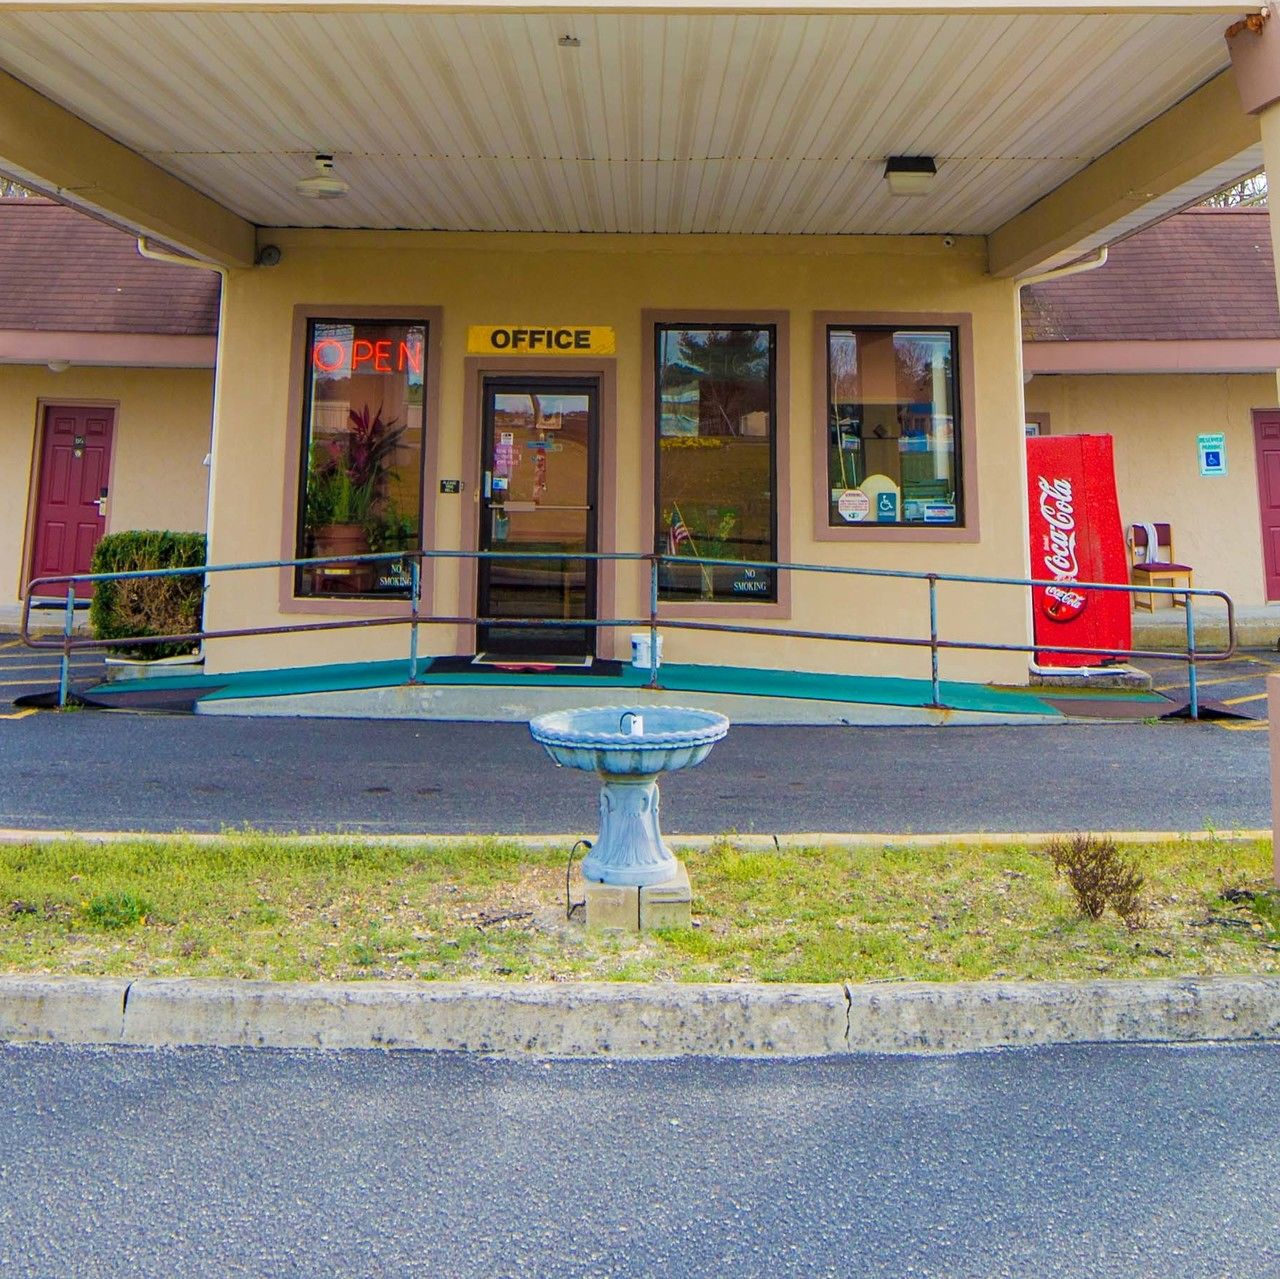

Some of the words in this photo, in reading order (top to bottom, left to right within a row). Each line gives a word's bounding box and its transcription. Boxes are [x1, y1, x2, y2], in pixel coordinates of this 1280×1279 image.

[491, 329, 591, 349] OFFICE
[313, 339, 422, 372] OPEN
[391, 564, 402, 574] NO
[745, 569, 756, 578] NO
[379, 577, 412, 586] SMOKING
[733, 581, 767, 591] SMOKING
